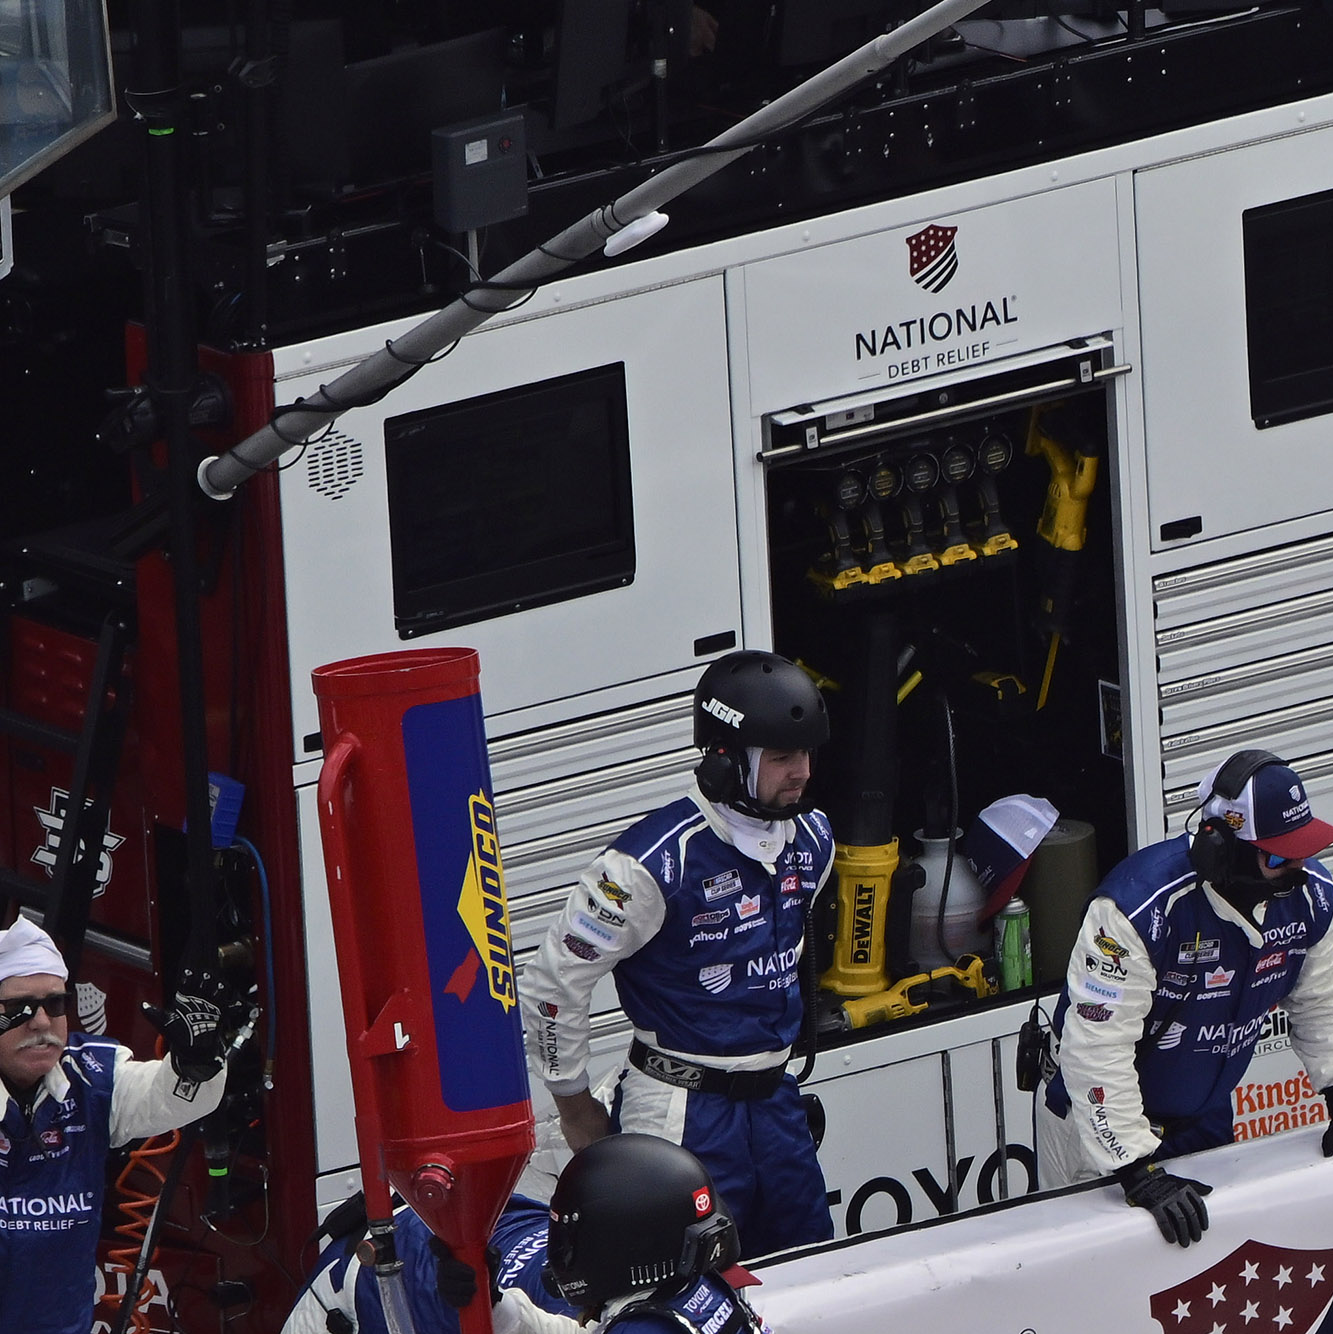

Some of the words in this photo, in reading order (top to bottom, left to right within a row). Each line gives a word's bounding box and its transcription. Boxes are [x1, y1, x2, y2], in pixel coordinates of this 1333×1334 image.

[855, 296, 1018, 361] NATIONAL
[888, 356, 931, 380] DEBT
[936, 341, 990, 367] RELIEF
[702, 697, 744, 729] JGR
[470, 791, 517, 1012] SUNOCO
[600, 907, 626, 924] DN
[853, 883, 876, 964] DEWALT
[1263, 921, 1307, 943] TOYOTA
[1101, 962, 1128, 976] DN
[1085, 981, 1118, 999] SIEMENS
[545, 1015, 560, 1075] NATIONAL
[1094, 1103, 1128, 1161] NATIONAL
[1233, 1100, 1332, 1143] awaiia
[34, 1219, 75, 1232] RELIEF
[683, 1284, 711, 1313] TOYOTA
